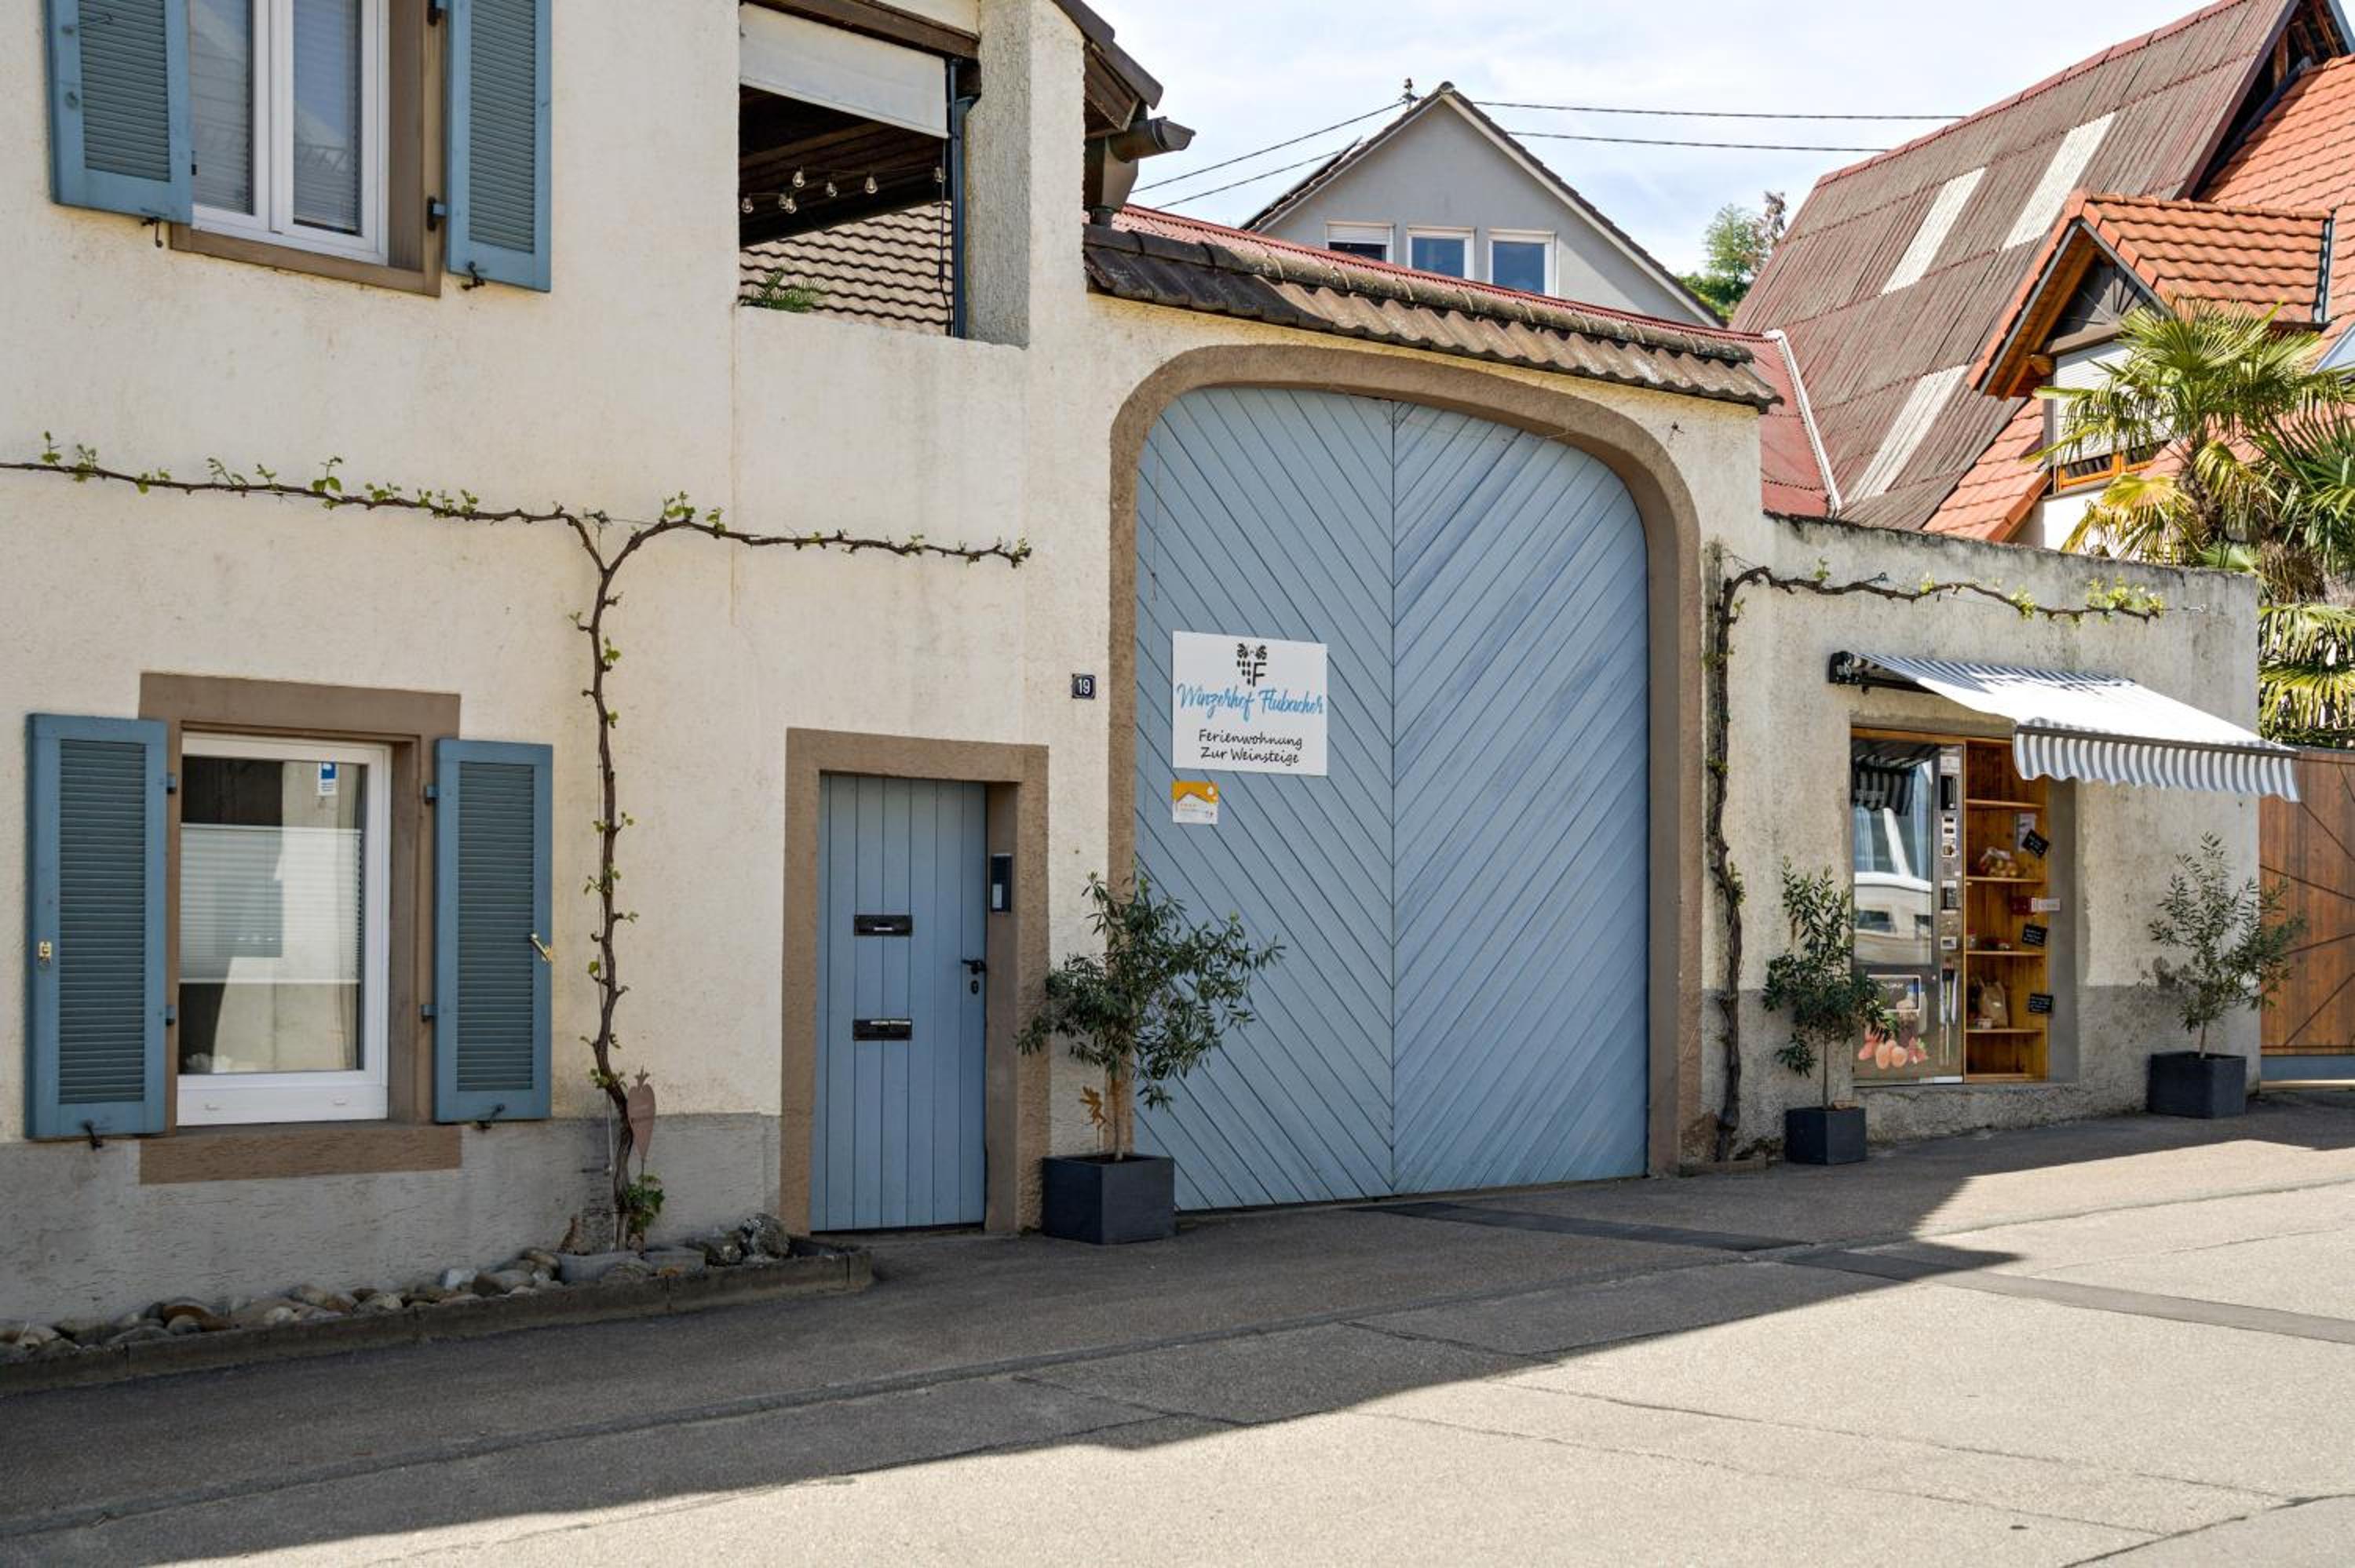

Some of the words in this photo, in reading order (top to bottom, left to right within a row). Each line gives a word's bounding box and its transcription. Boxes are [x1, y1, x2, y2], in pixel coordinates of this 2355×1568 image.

[1078, 679, 1090, 695] 19
[1177, 683, 1254, 721] Winzerhof
[1198, 728, 1302, 750] Ferienwohnung
[1200, 746, 1228, 760] Zur
[1230, 747, 1300, 767] Weinsteige
